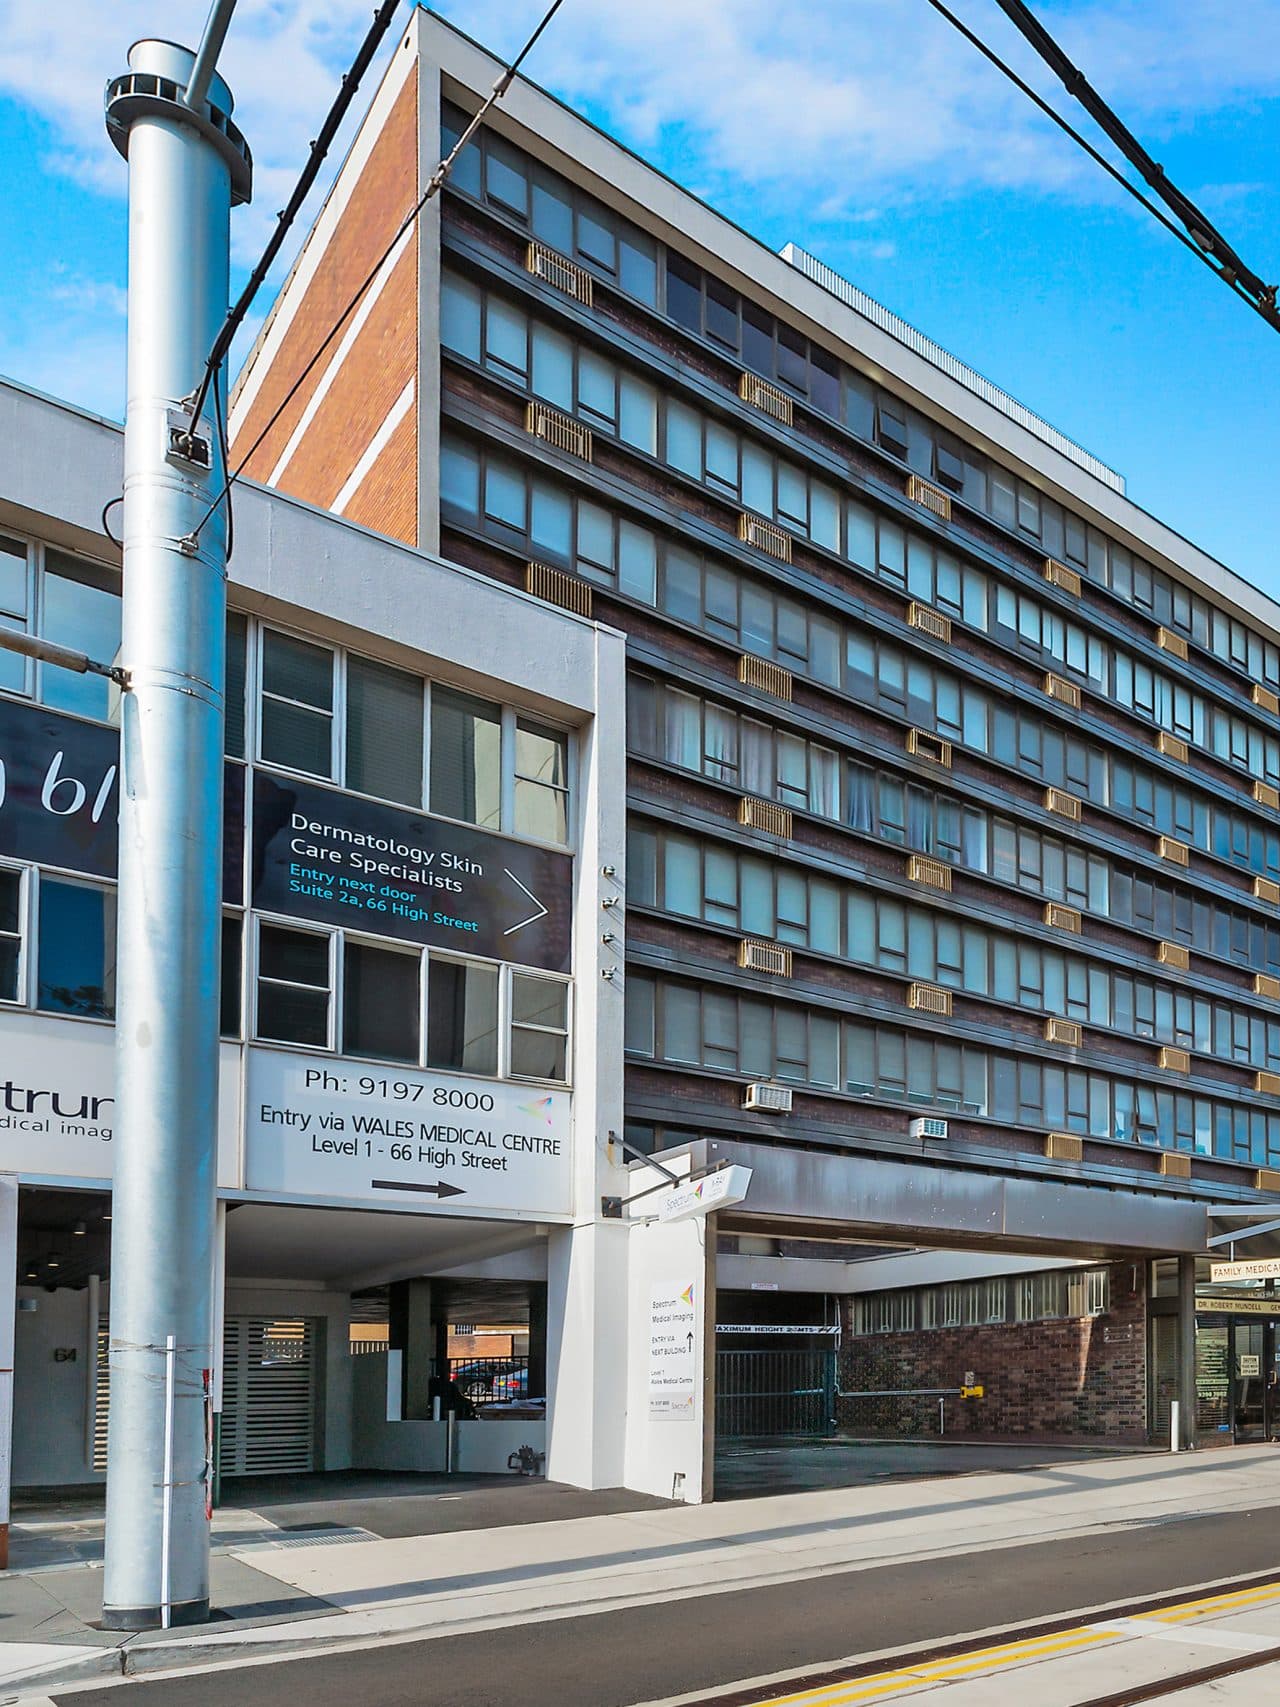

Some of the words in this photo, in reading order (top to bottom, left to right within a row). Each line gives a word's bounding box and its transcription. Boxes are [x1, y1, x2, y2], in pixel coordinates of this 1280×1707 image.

[290, 838, 342, 864] Care
[349, 852, 464, 893] Specialists
[291, 812, 435, 866] Dermatology
[440, 851, 484, 876] Skin
[289, 879, 333, 900] Suite
[339, 890, 364, 908] 2a,
[366, 899, 388, 911] 66
[392, 902, 429, 922] High
[433, 912, 479, 932] Street
[290, 863, 335, 885] Entry
[339, 876, 375, 894] next
[380, 884, 417, 902] door
[305, 1069, 348, 1093] Ph:
[358, 1076, 425, 1102] 9197
[433, 1086, 495, 1112] 8000
[260, 1104, 312, 1131] Entry
[318, 1111, 345, 1131] via
[351, 1115, 415, 1139] WALES
[420, 1123, 497, 1148] MEDICAL
[501, 1134, 562, 1156] CENTRE
[312, 1135, 358, 1156] Level
[364, 1139, 372, 1157] 1
[390, 1143, 413, 1161] 66
[418, 1148, 456, 1170] High
[461, 1150, 509, 1172] Street
[1213, 1266, 1242, 1278] FAMILY
